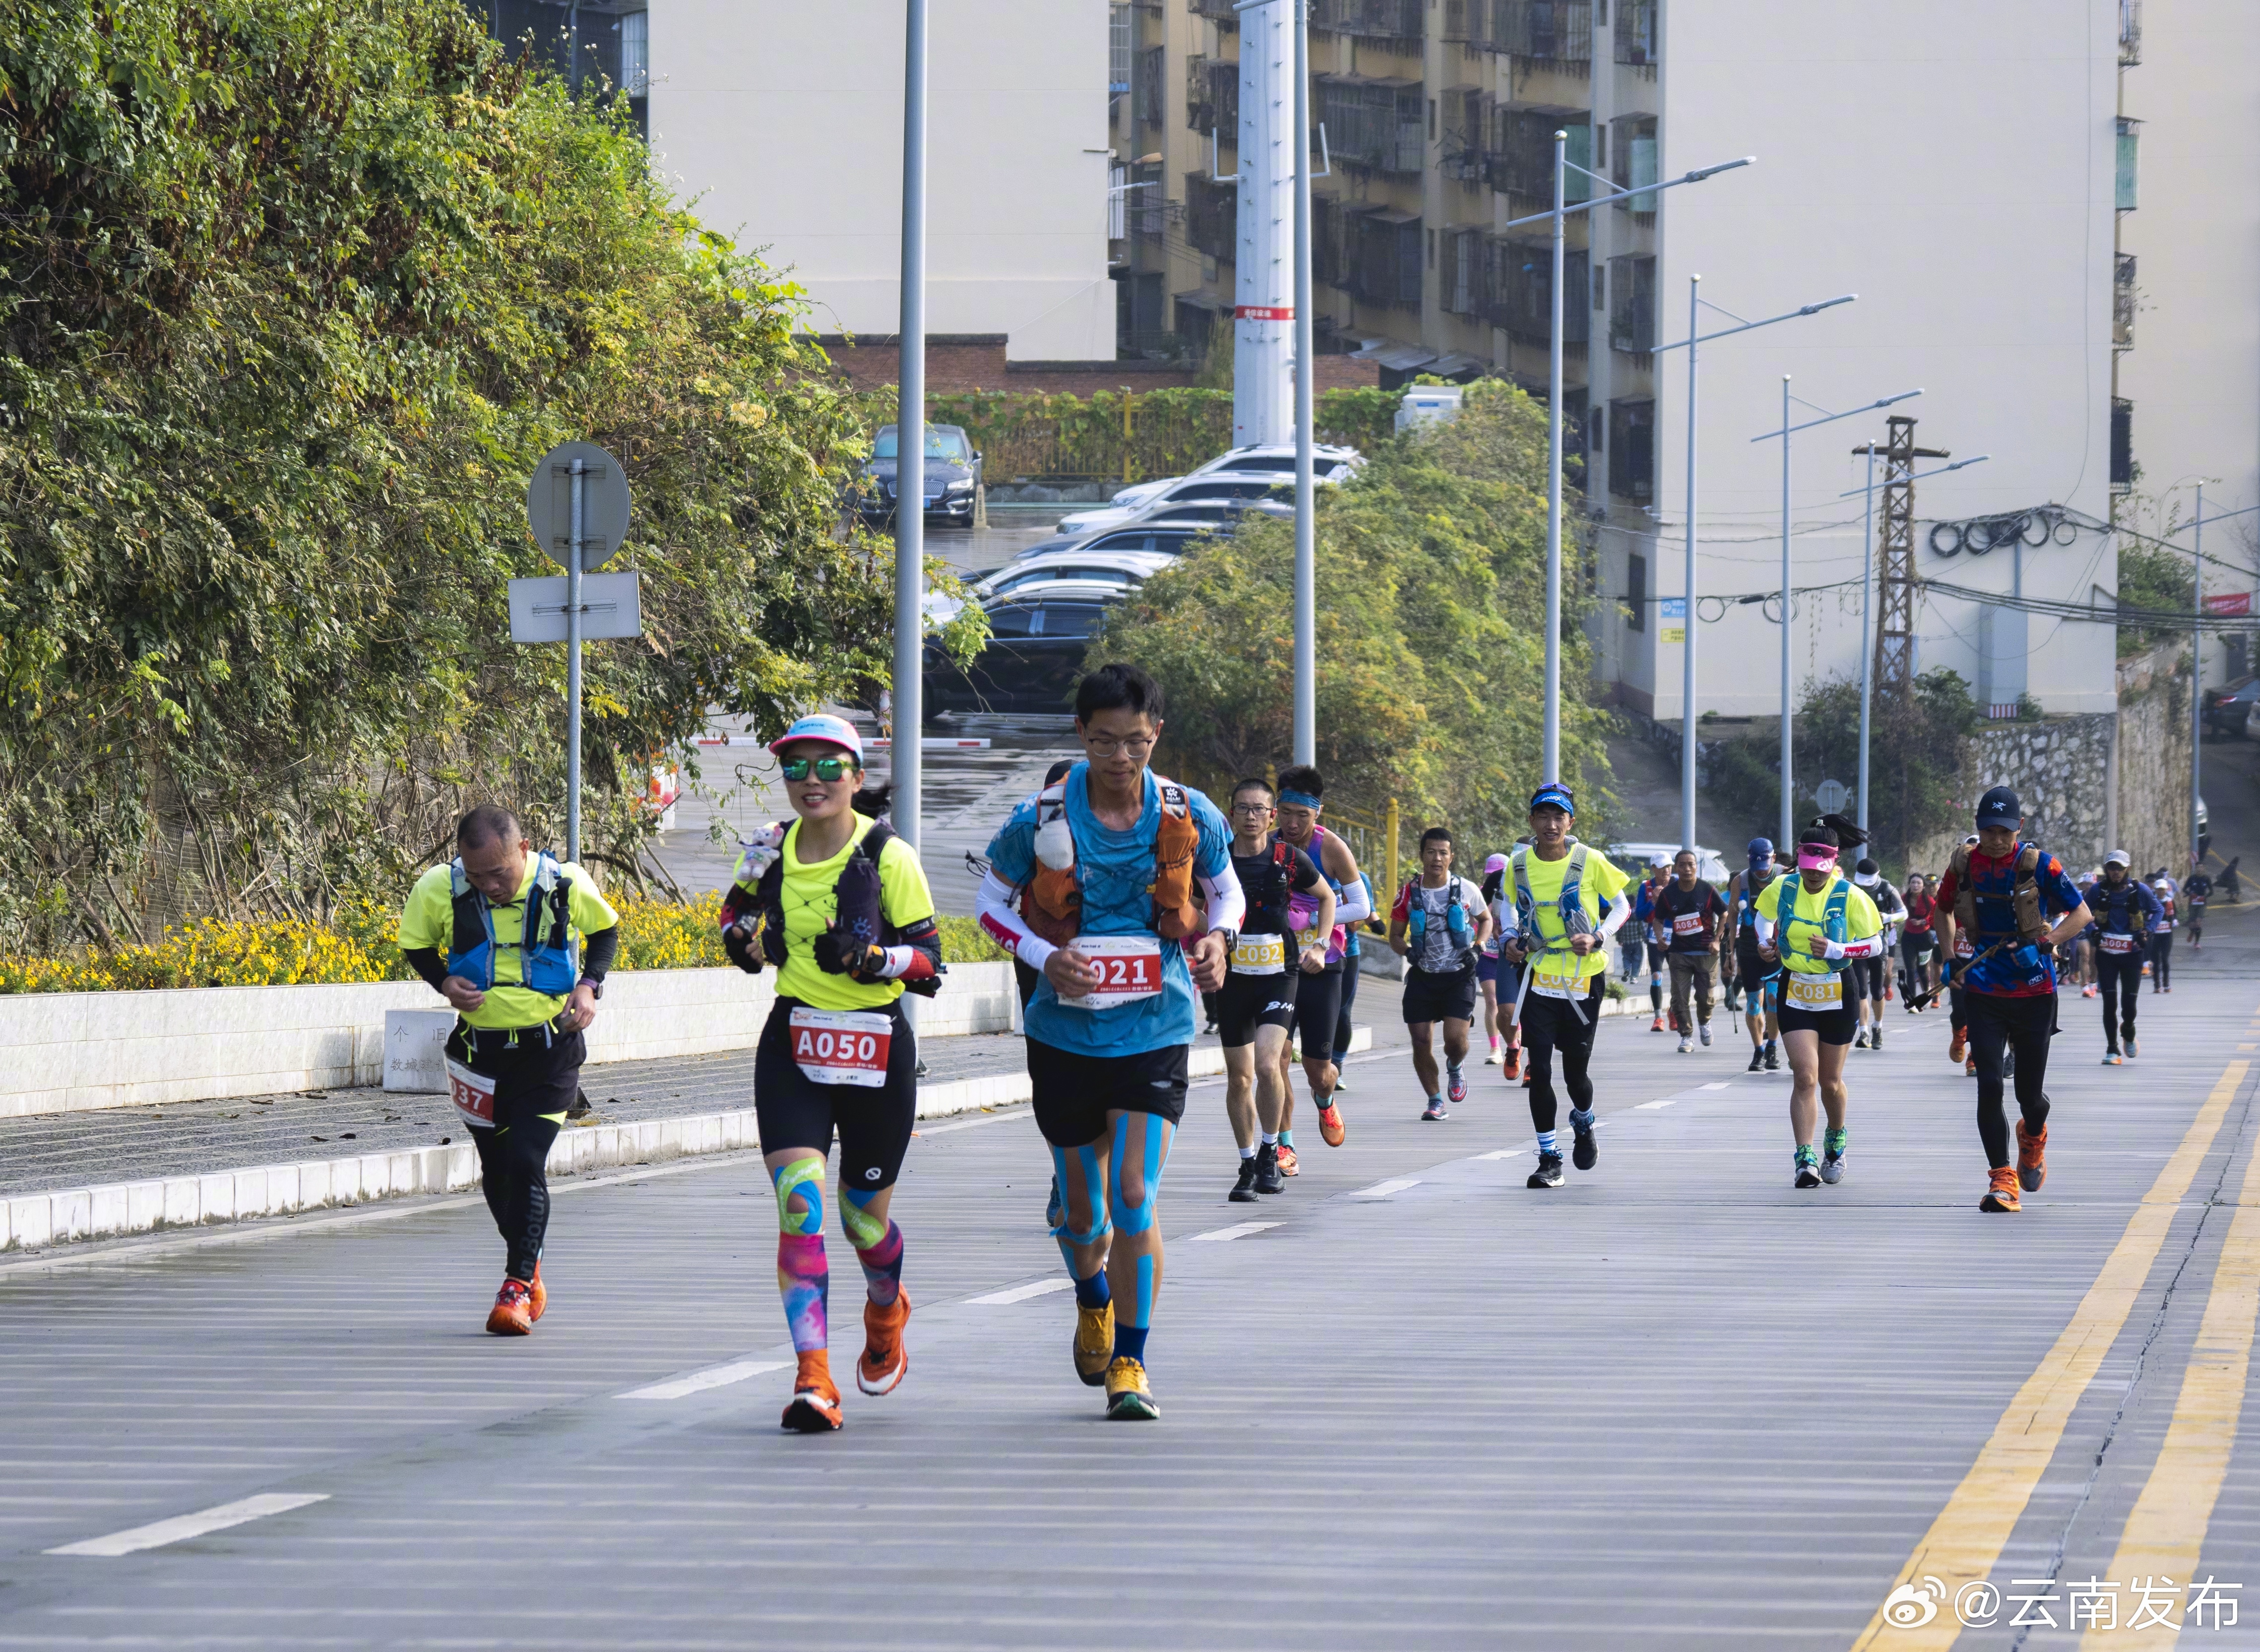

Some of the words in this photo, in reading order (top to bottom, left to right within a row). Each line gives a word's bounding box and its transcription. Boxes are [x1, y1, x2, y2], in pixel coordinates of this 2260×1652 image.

[1676, 919, 1698, 930] A084
[1235, 945, 1280, 962] C092
[2028, 973, 2043, 985] KMZY
[1792, 983, 1836, 1000] C081
[797, 1029, 877, 1061] A050
